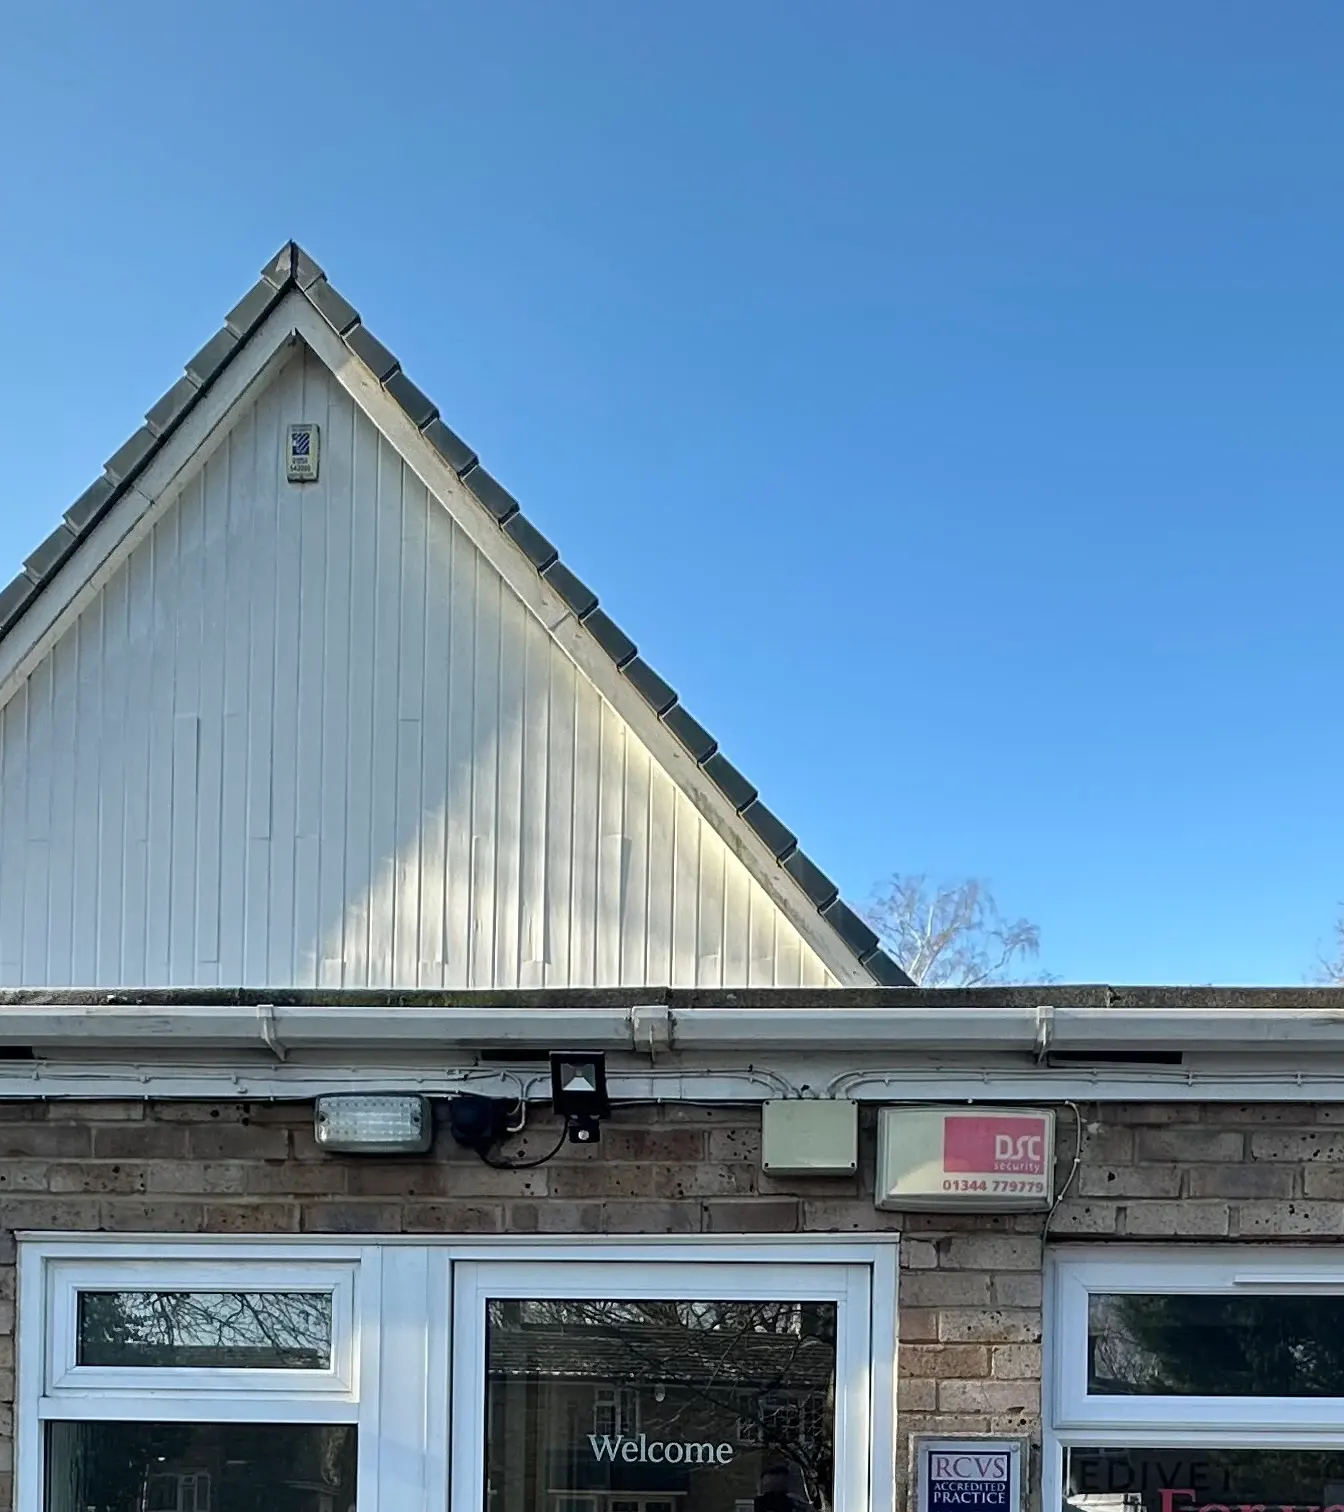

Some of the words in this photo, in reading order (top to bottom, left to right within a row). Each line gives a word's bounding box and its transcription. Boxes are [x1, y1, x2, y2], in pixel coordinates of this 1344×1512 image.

[995, 1135, 1041, 1161] DSC
[993, 1161, 1041, 1174] security
[942, 1179, 988, 1193] 01344
[991, 1180, 1044, 1194] 779779
[587, 1433, 734, 1465] Welcome
[936, 1456, 1005, 1479] RCVS
[933, 1482, 1006, 1492] ACCREDITED
[933, 1491, 1006, 1504] PRACTICE
